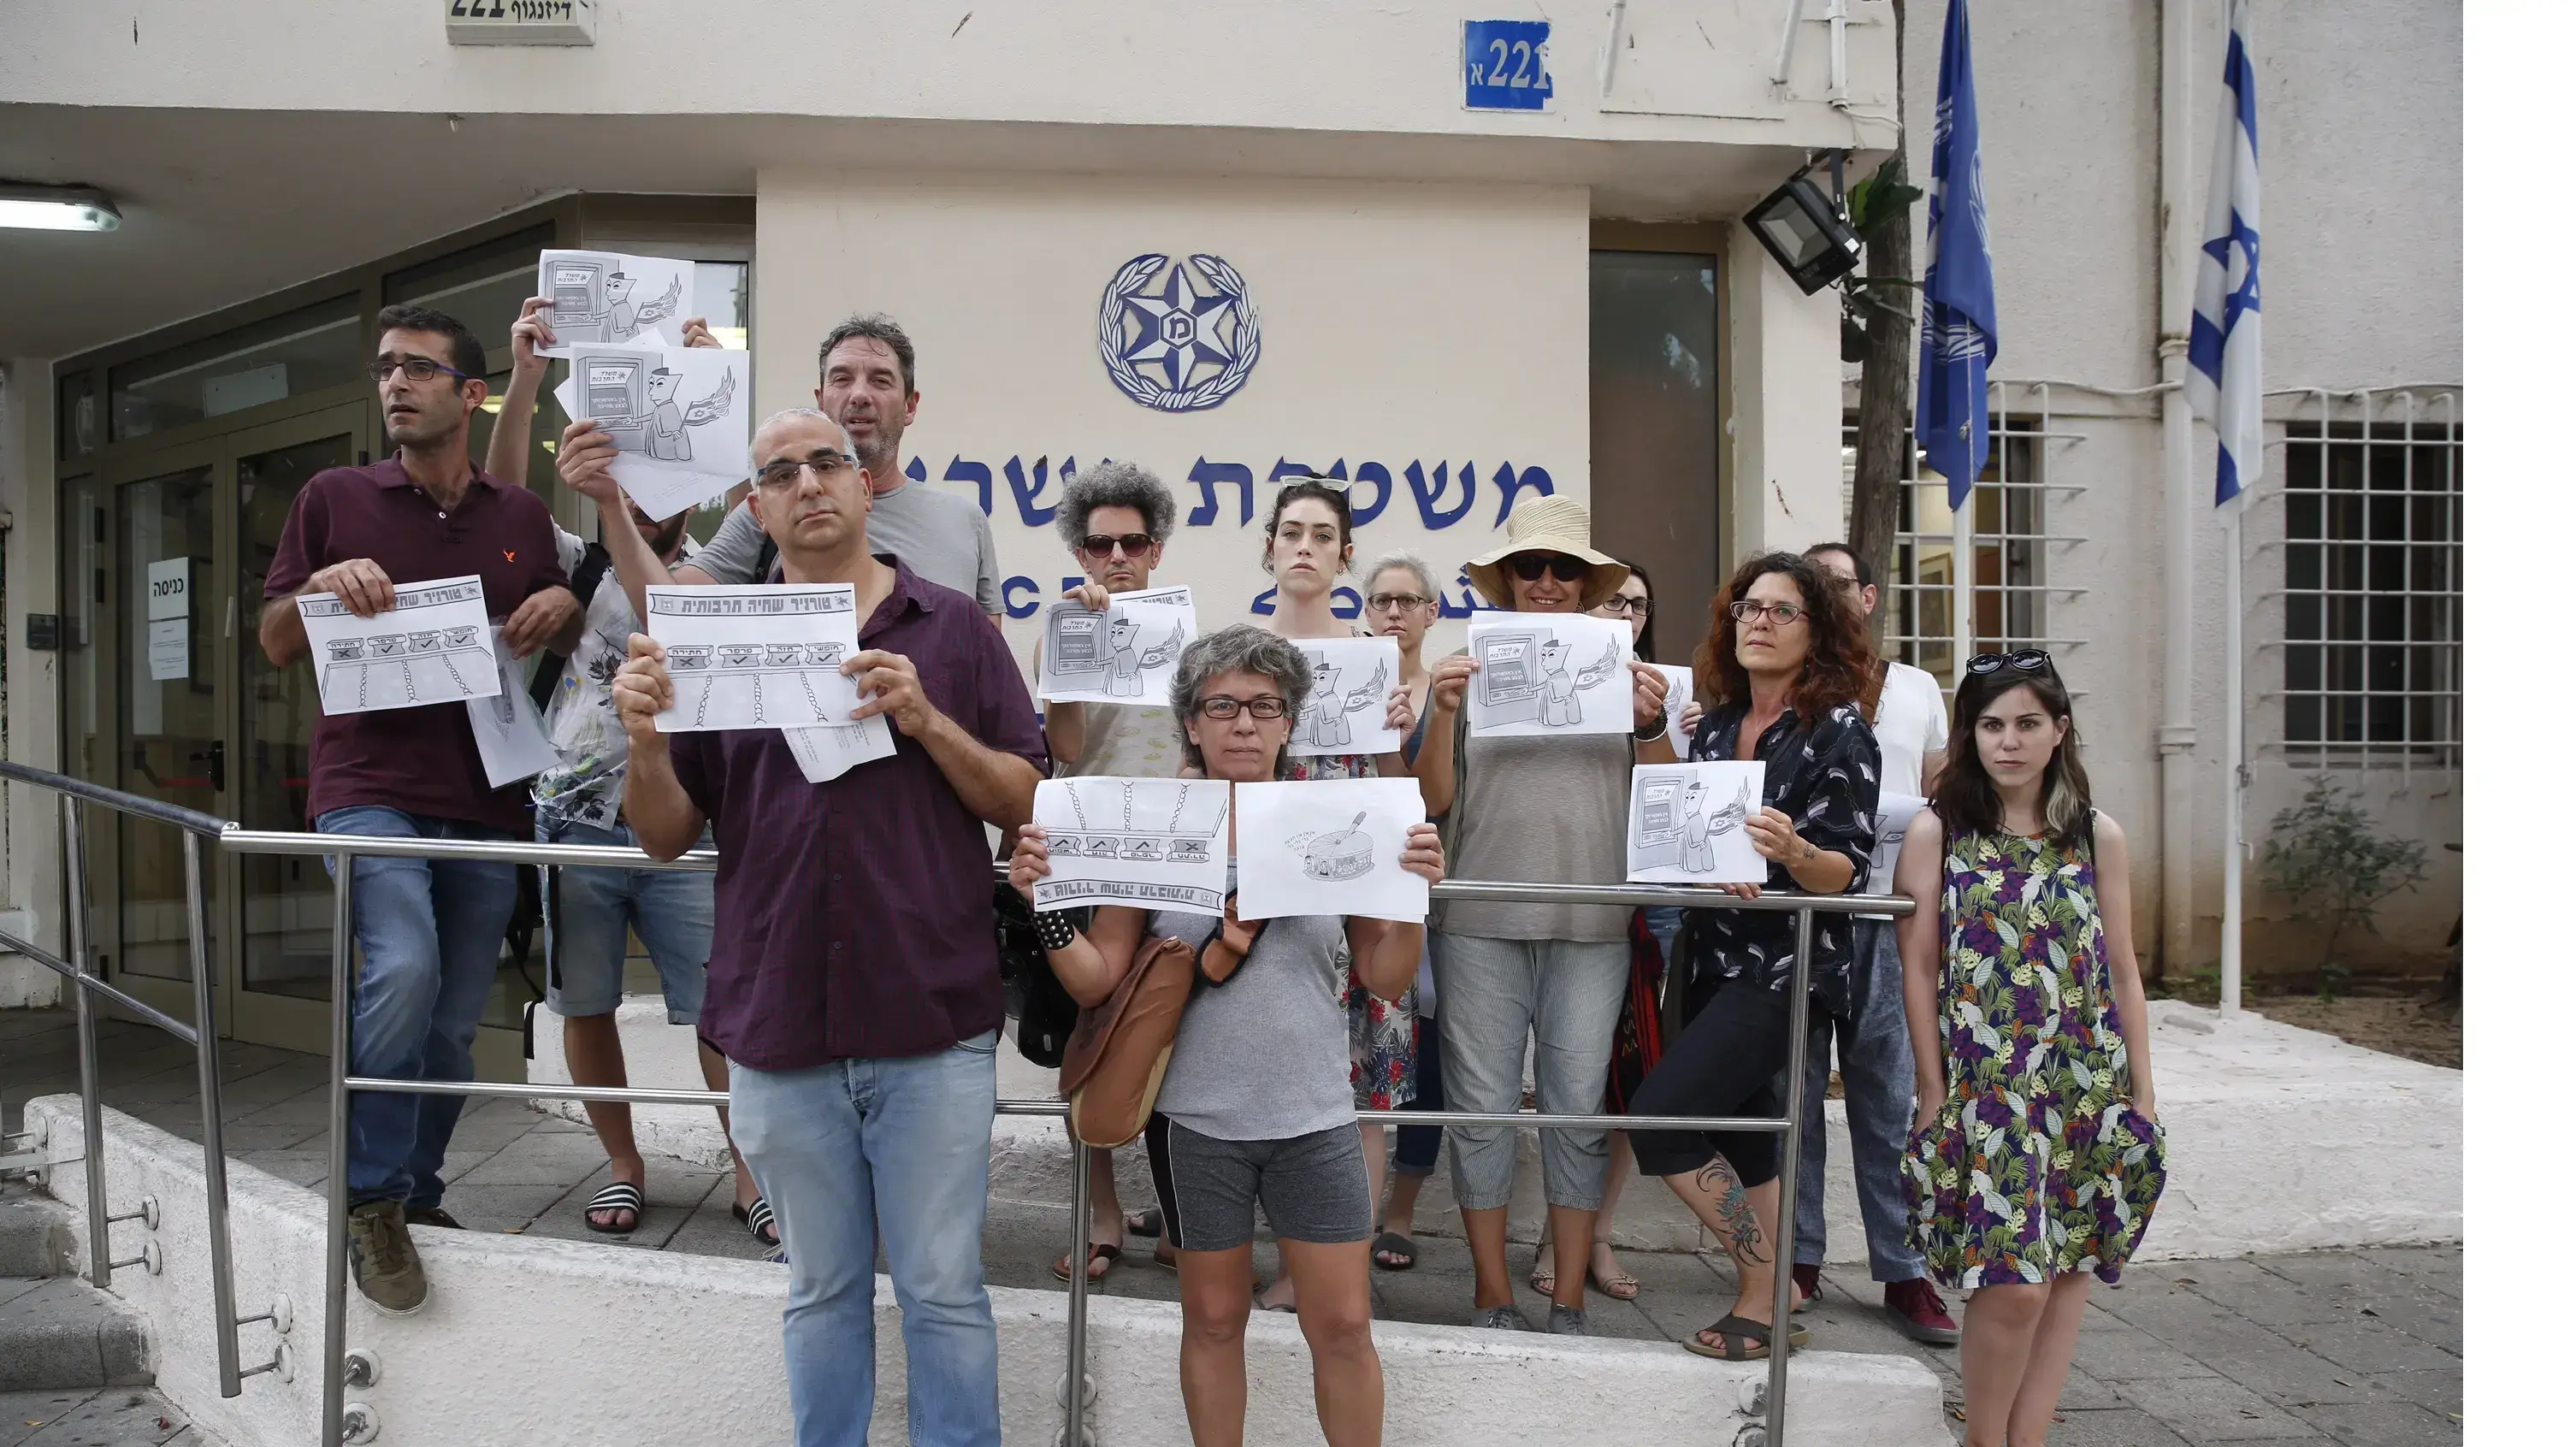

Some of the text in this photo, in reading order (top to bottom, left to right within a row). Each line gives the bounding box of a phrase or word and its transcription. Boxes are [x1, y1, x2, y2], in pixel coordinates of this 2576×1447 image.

[1470, 38, 1549, 89] 221 א
[153, 577, 184, 597] כניסה
[423, 588, 463, 604] טורניר
[682, 596, 830, 613] טורניר שחיה תרבותית
[1054, 882, 1195, 900] טורניר שחיה תרבותית
